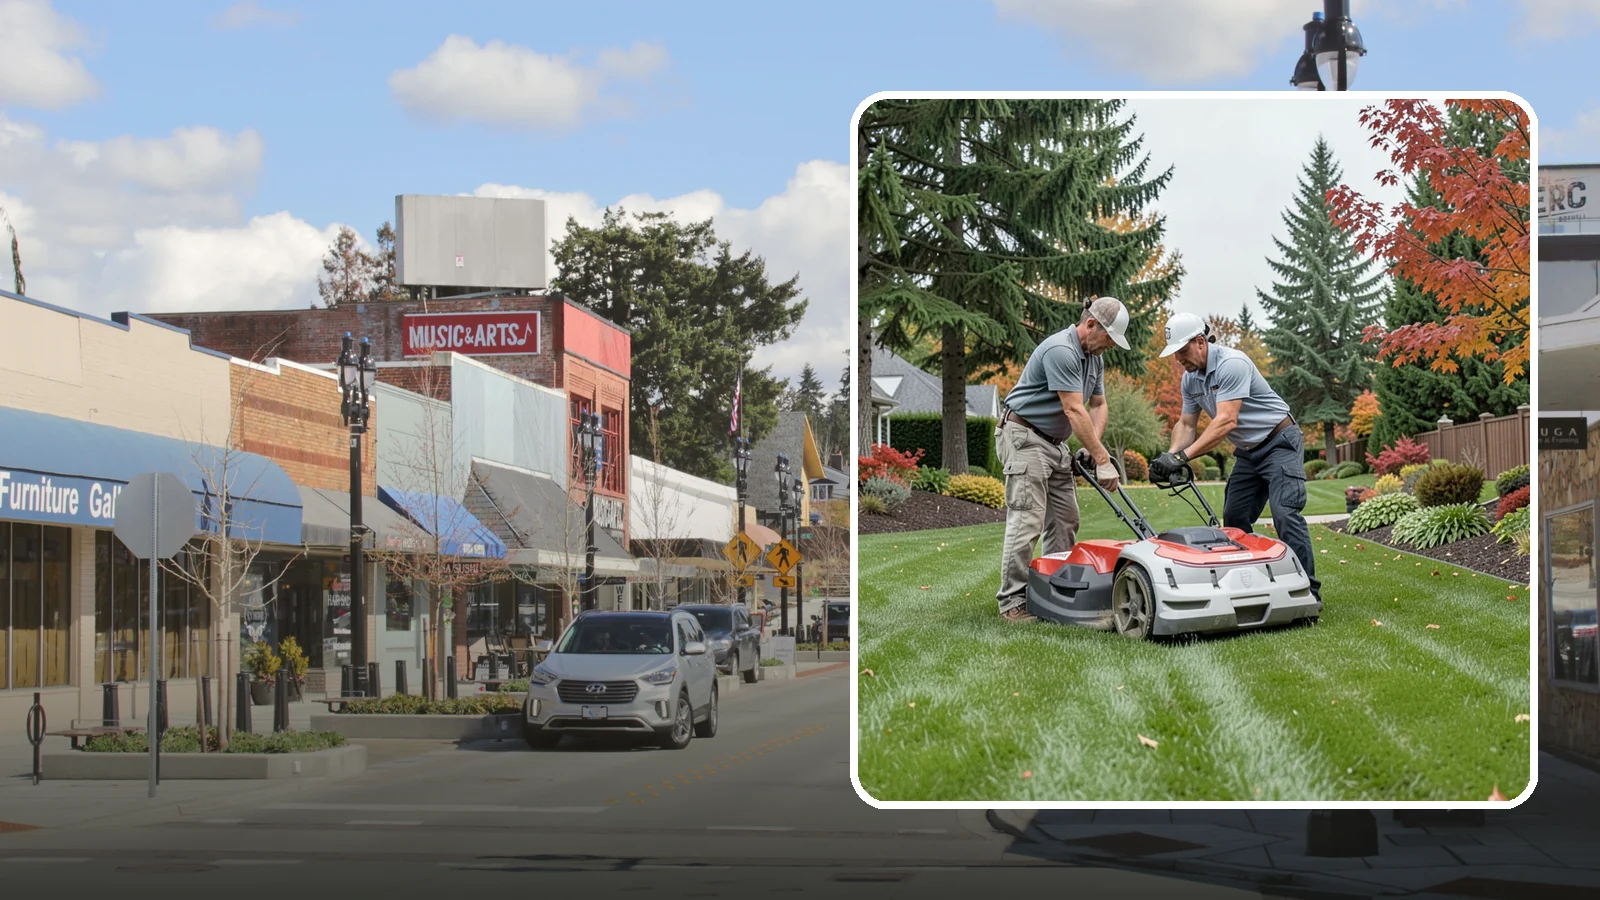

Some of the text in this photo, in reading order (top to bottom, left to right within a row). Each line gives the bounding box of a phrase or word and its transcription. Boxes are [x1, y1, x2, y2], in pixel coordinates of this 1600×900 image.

[0, 471, 121, 519] Furniture Gal
[453, 563, 479, 574] SUSHI
